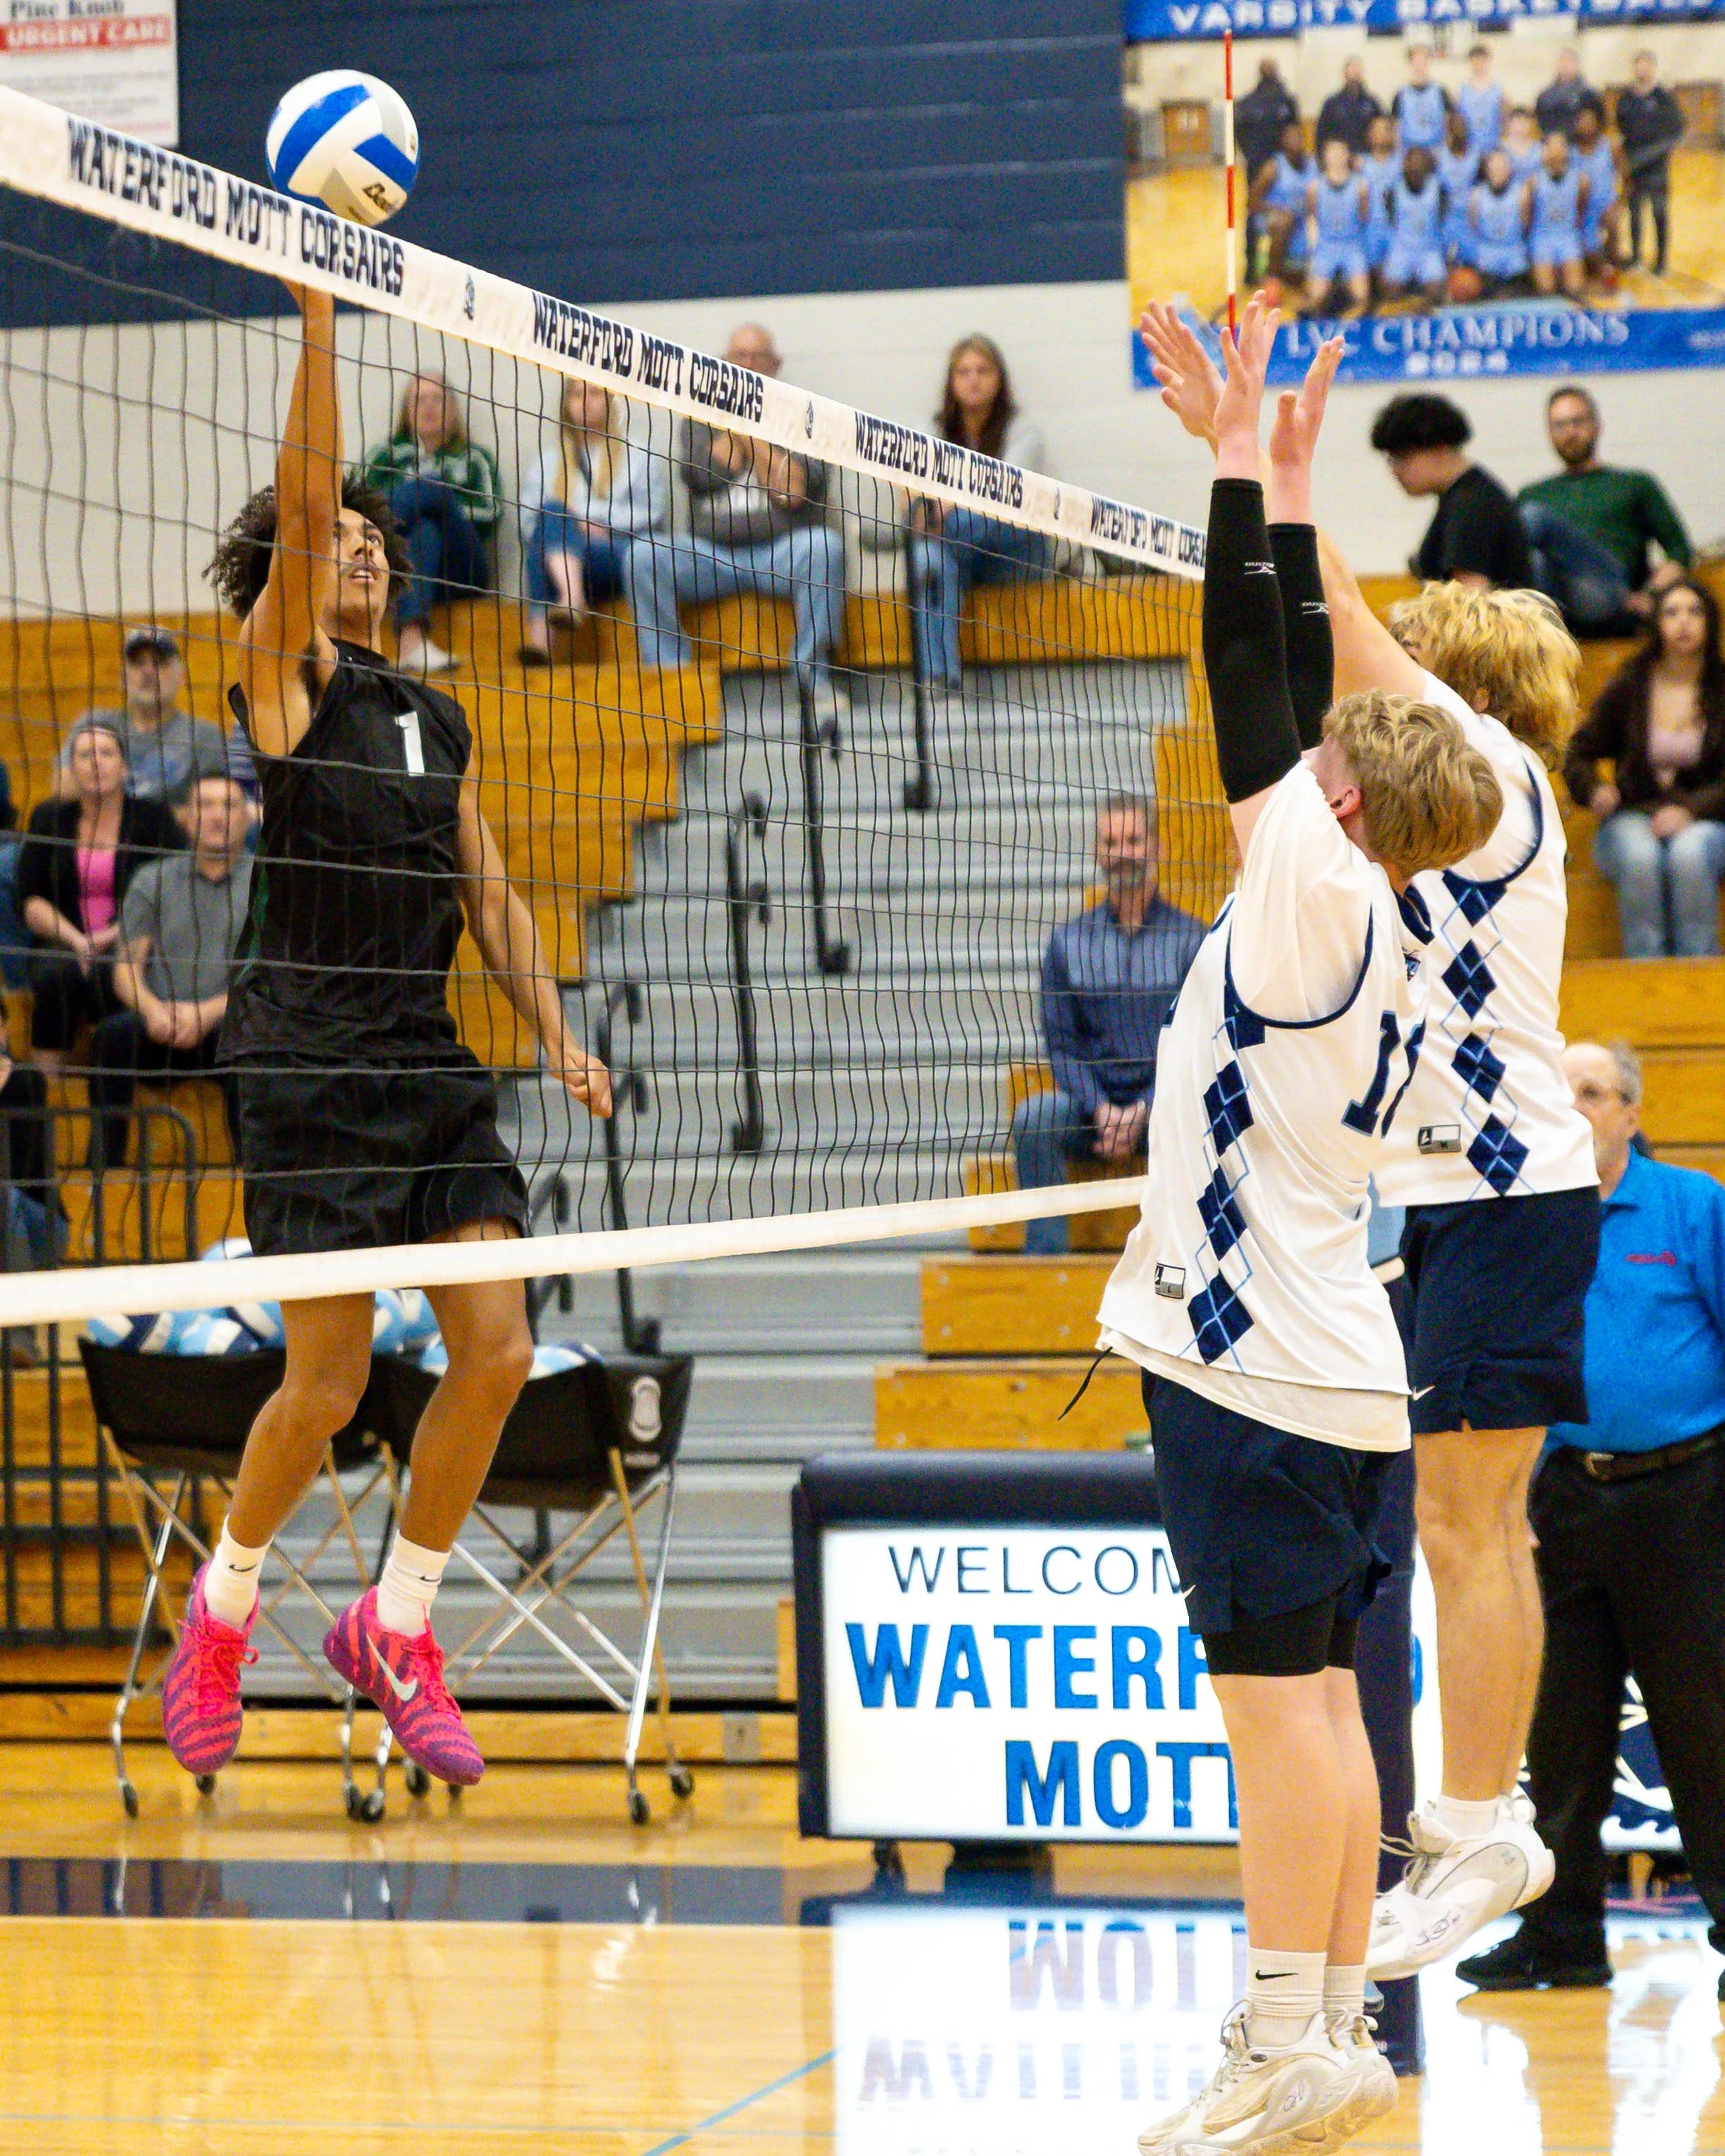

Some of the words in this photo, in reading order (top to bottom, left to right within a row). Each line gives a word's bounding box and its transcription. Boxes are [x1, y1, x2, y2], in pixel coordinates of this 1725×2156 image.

[8, 21, 99, 49] URGENT
[107, 15, 167, 44] CARE
[1167, 0, 1376, 32] VARSITY
[68, 116, 215, 228] WATERFORD
[225, 177, 291, 256] MOTT
[300, 208, 405, 297] CORSAIRS
[532, 291, 633, 378] WATERFORD
[637, 332, 685, 396] MOTT
[689, 351, 764, 423] CORSAIRS
[1374, 313, 1630, 354] CHAMPIONS
[854, 411, 928, 478] WATERFORD
[931, 437, 966, 491] MOTT
[969, 449, 1023, 509] CORSAIRS
[1178, 525, 1207, 568] CORSA
[394, 711, 425, 777] 1
[888, 1545, 1182, 1595] WELCOM
[845, 1622, 1209, 1710] WATERF
